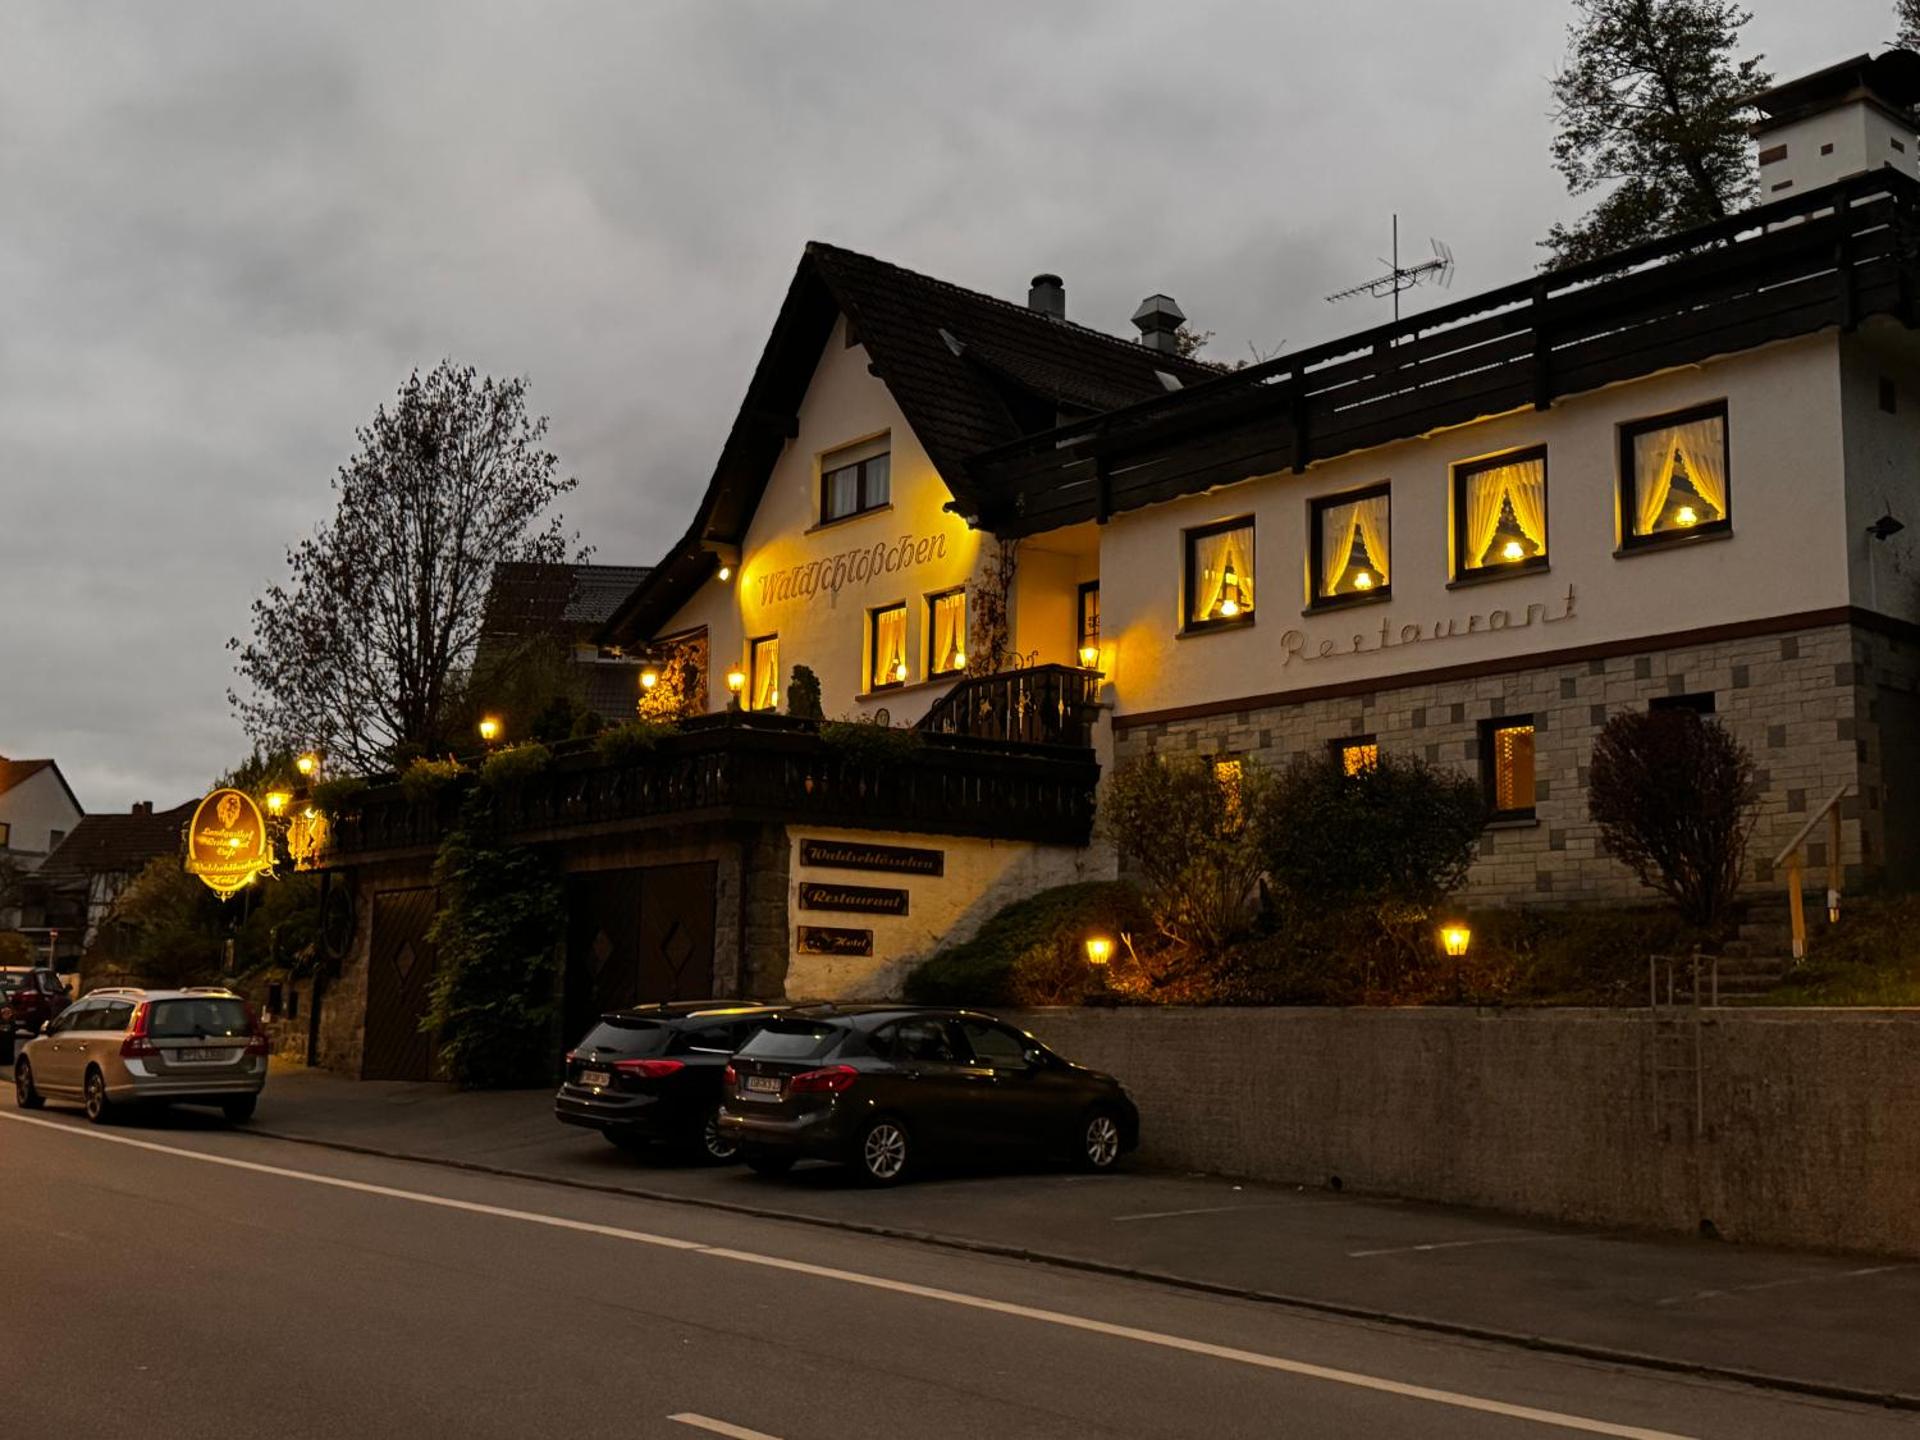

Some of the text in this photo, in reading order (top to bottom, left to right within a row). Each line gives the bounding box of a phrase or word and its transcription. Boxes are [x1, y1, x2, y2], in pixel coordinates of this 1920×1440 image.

[1281, 583, 1577, 667] Restaurant
[813, 890, 900, 907] Restaurant
[834, 937, 867, 948] Hotel
